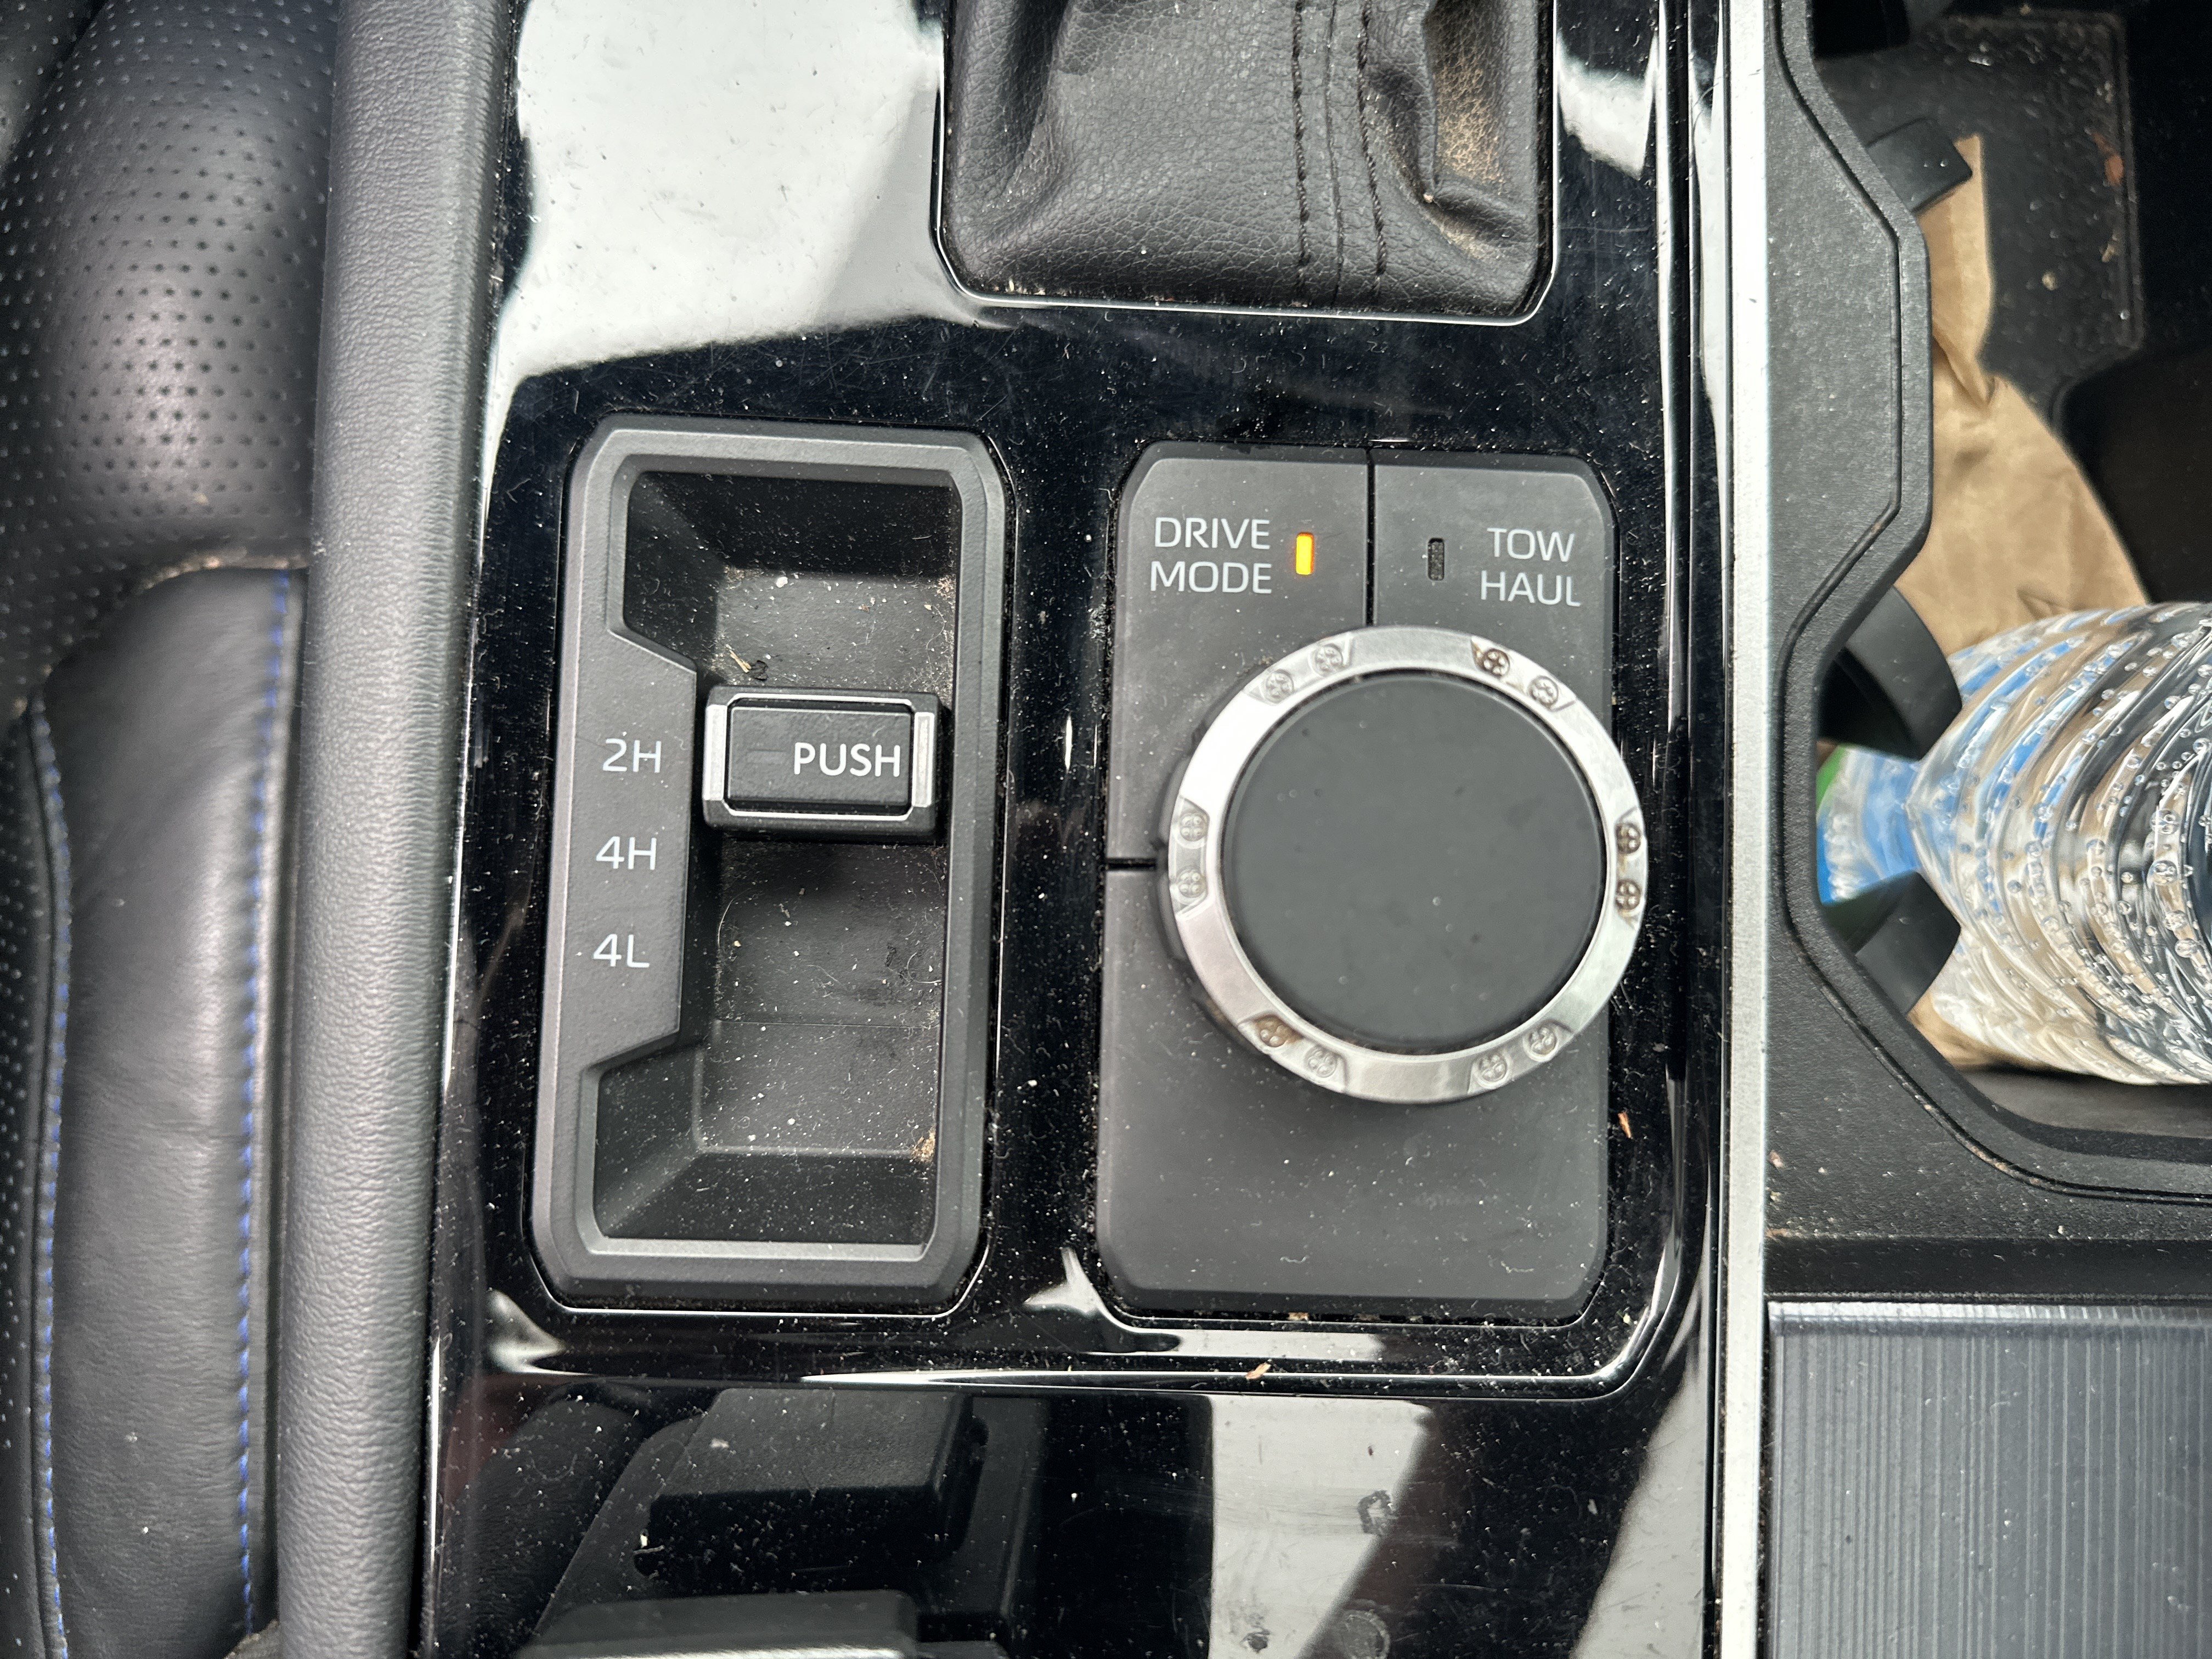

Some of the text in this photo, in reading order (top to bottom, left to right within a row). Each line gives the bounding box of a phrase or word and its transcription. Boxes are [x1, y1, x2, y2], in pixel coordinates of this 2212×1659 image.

[1154, 516, 1271, 550] DRIVE
[1486, 527, 1575, 563] TOW
[1150, 560, 1272, 594] MODE
[1480, 569, 1582, 607] HAUL
[602, 737, 662, 774] 2H
[793, 741, 901, 778] PUSH
[595, 836, 658, 871] 4H
[592, 933, 651, 968] 4L
